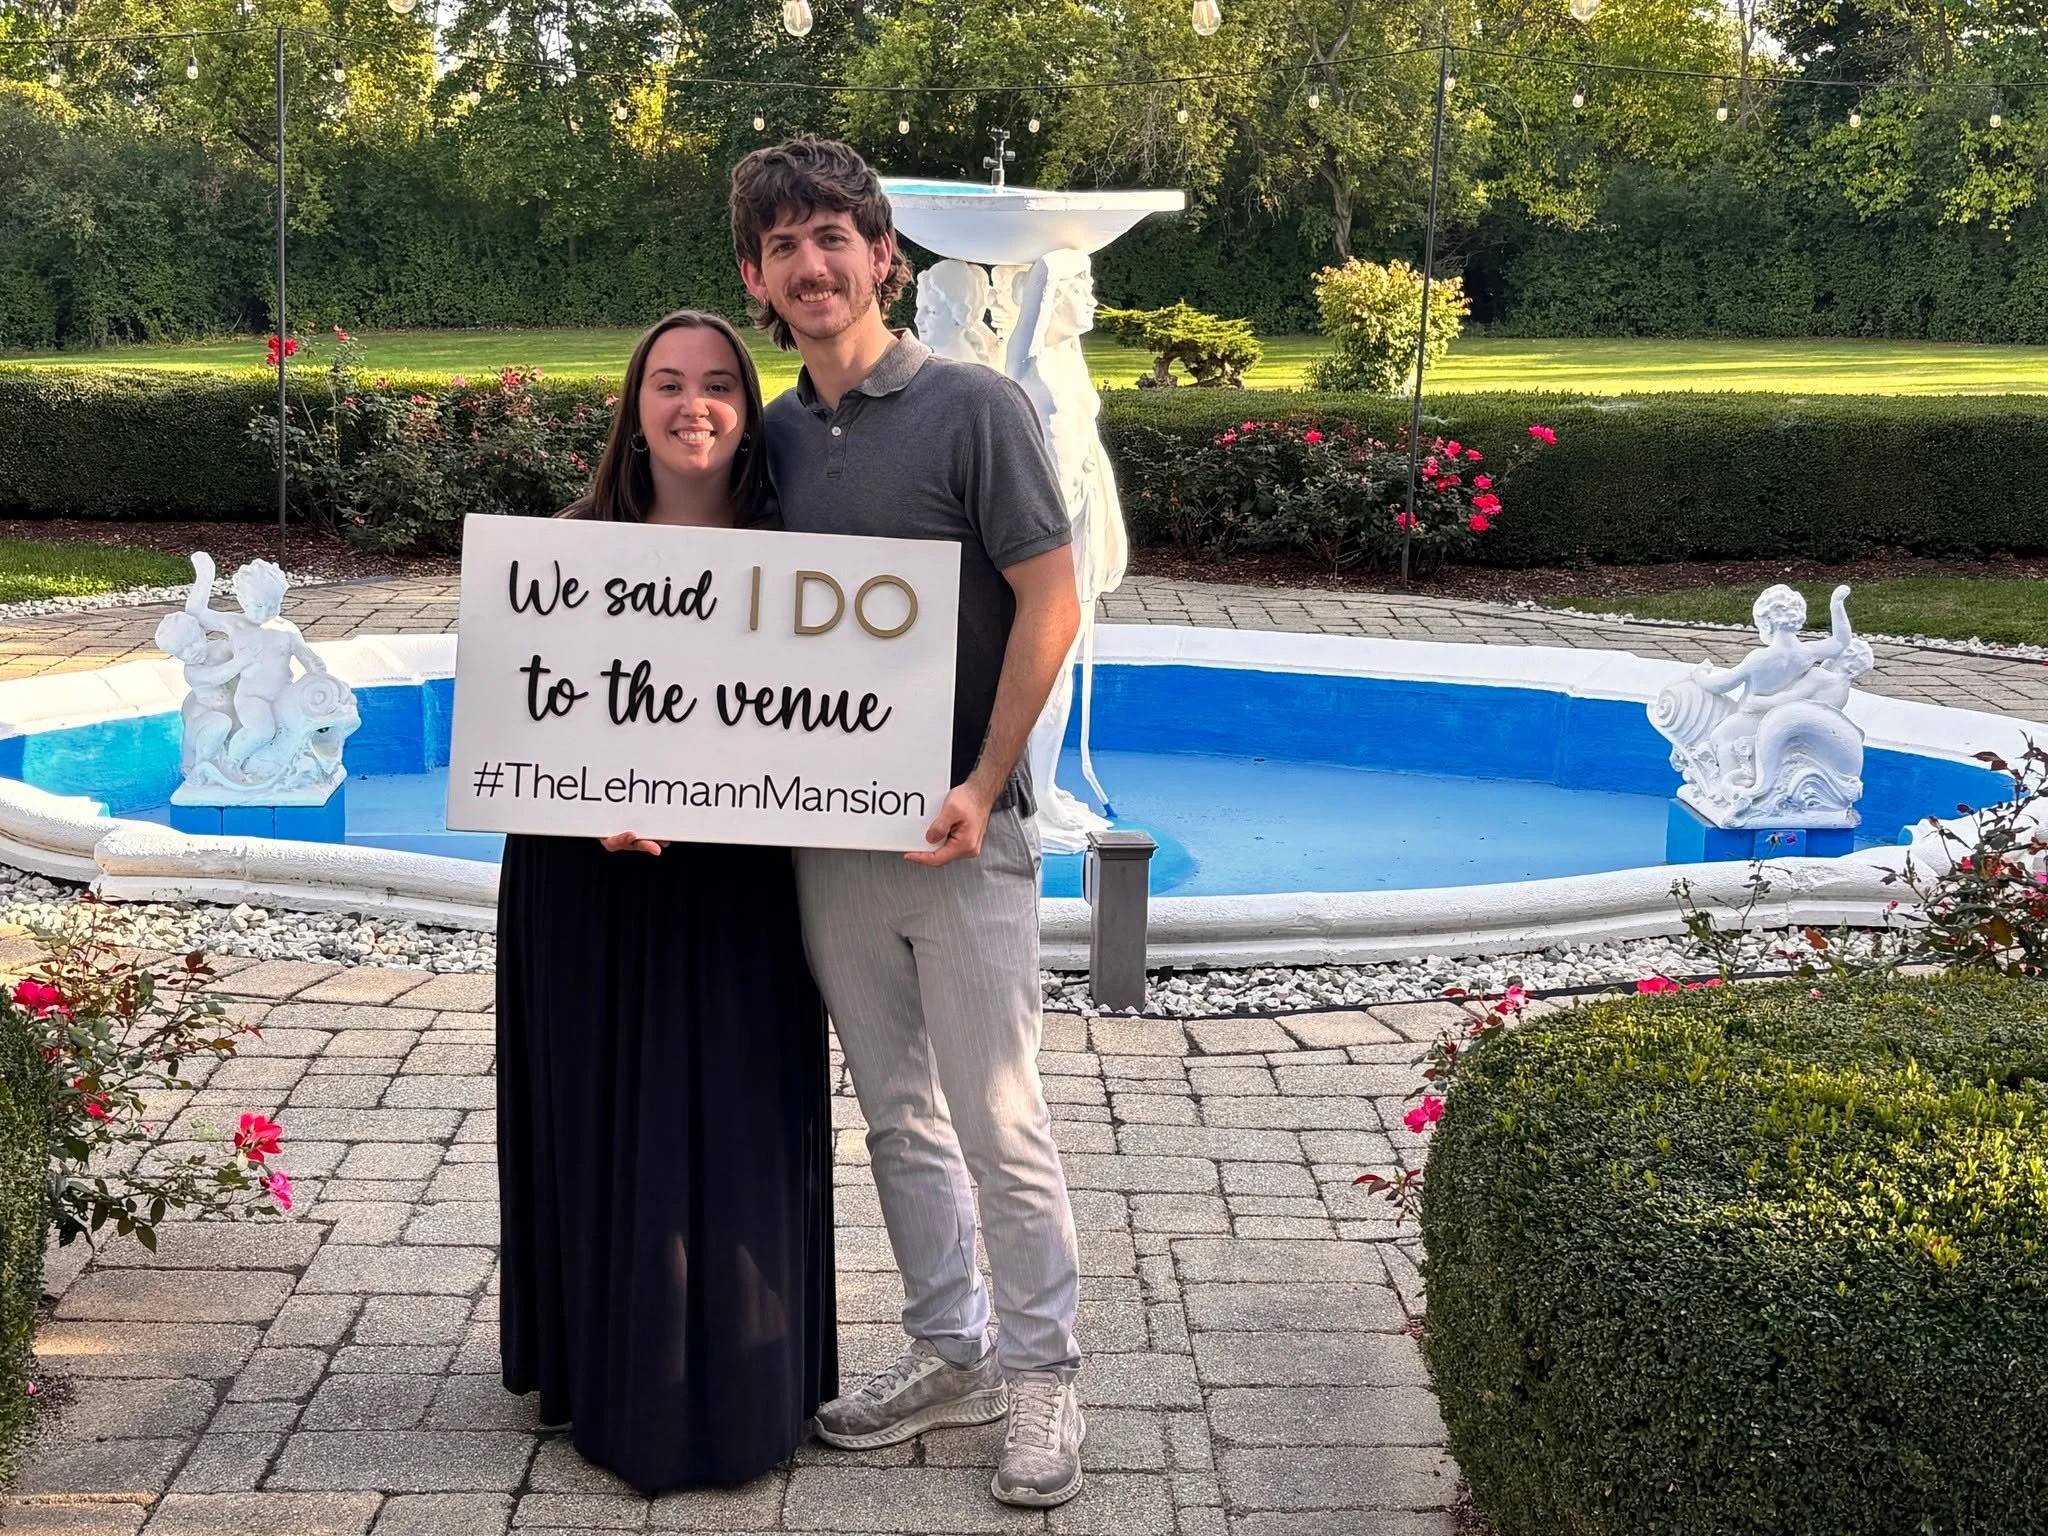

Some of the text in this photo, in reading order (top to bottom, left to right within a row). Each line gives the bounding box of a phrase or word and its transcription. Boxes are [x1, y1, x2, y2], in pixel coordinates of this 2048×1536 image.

[508, 559, 919, 641] We said I DO
[519, 654, 893, 734] to the venue
[473, 761, 925, 817] #TheLehmannMansion
